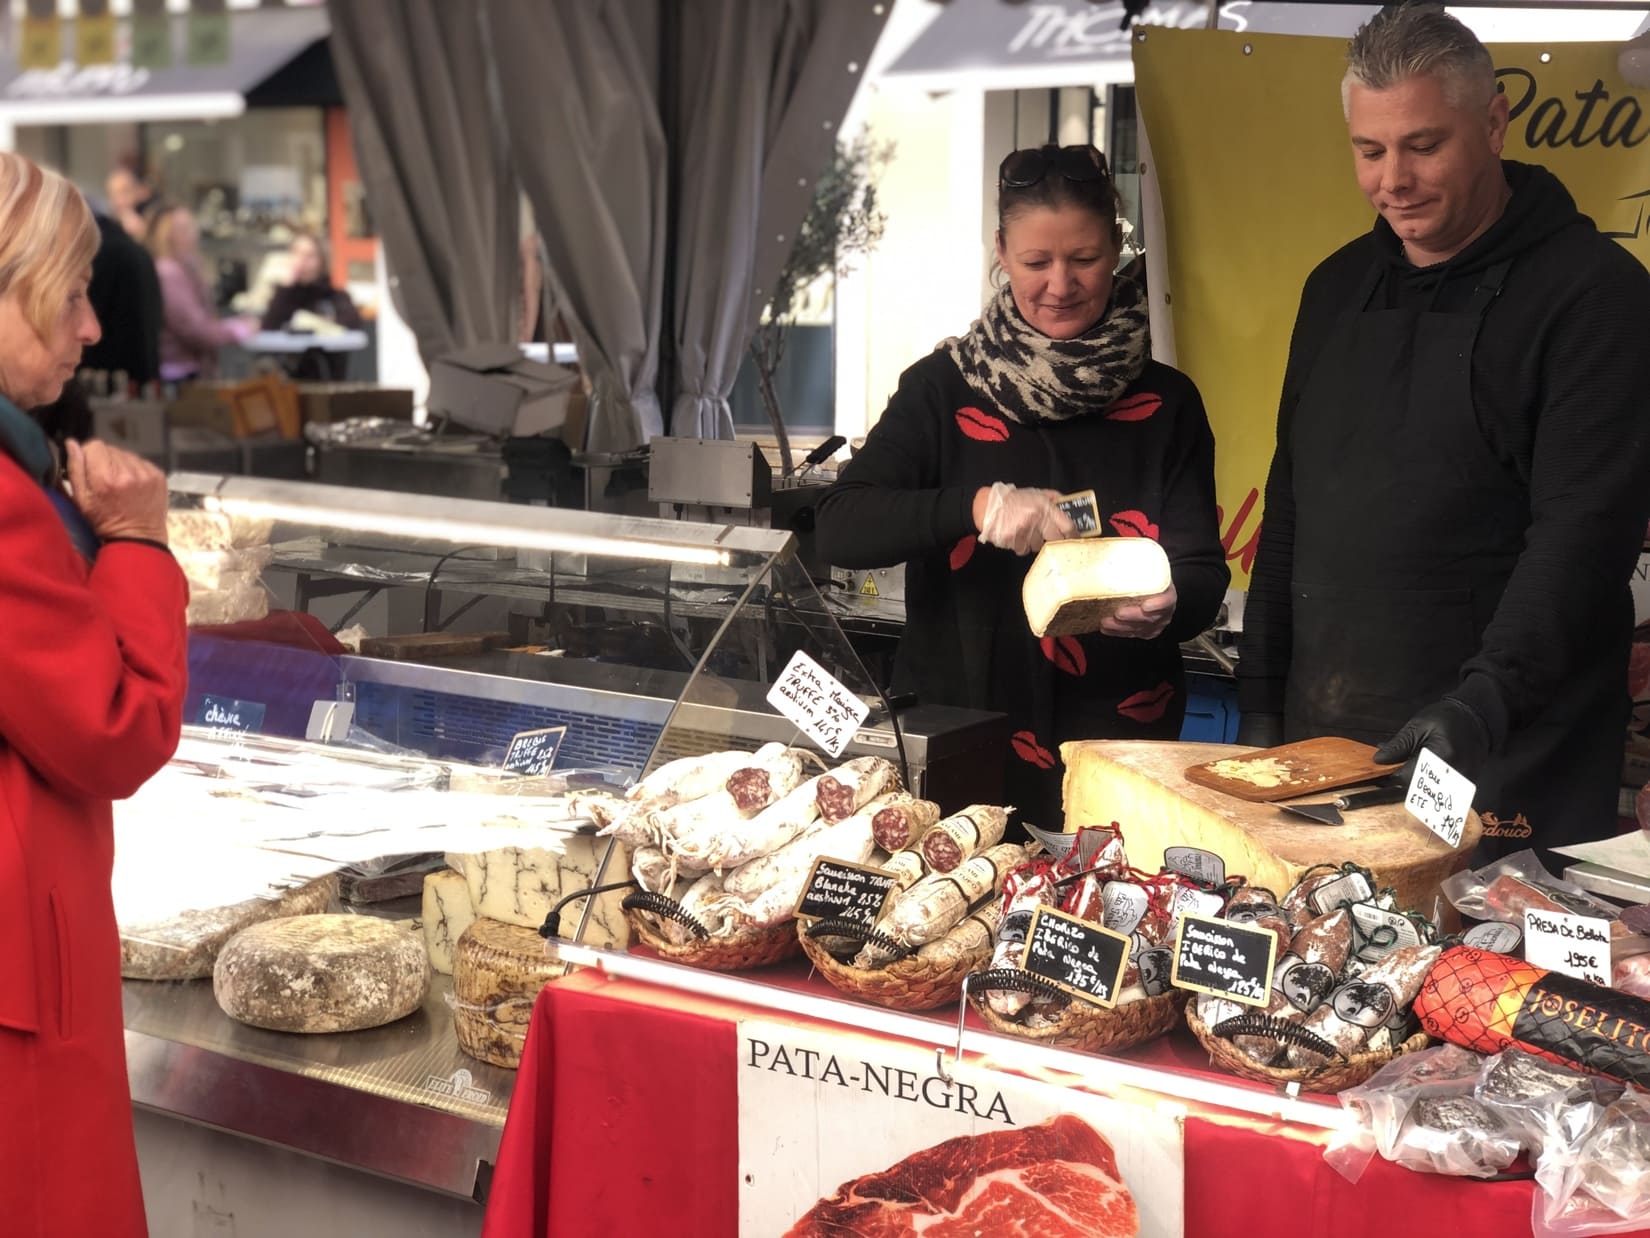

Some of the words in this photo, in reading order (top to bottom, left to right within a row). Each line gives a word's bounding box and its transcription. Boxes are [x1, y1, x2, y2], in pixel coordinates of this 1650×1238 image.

[792, 662, 823, 692] Extra
[205, 704, 241, 726] chèvre
[1526, 913, 1560, 934] PRESA
[1560, 925, 1576, 939] De
[1576, 924, 1610, 944] Bellota
[1032, 940, 1056, 960] Pata
[1062, 954, 1099, 975] Negra
[1087, 945, 1100, 963] de
[1180, 952, 1202, 971] Pata
[1231, 948, 1247, 965] de
[747, 1038, 1016, 1125] PATA-NEGRA
